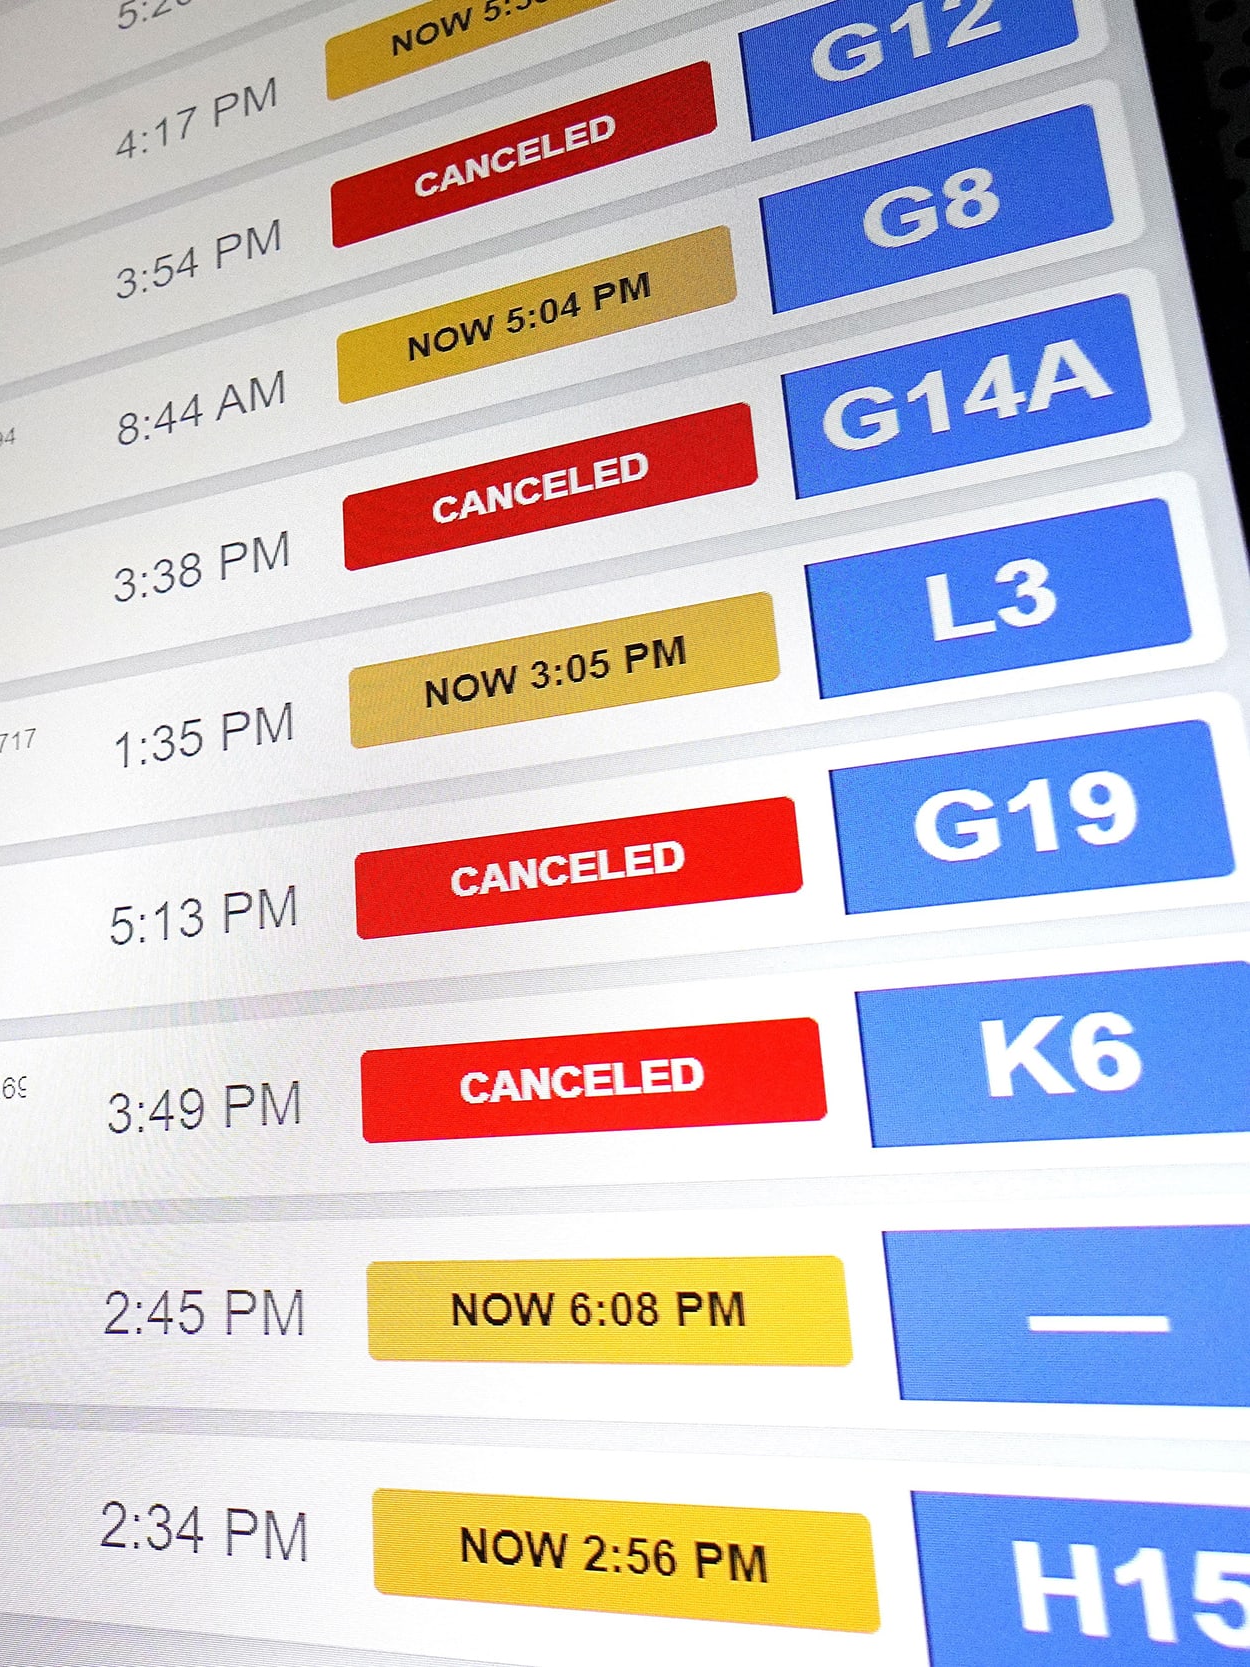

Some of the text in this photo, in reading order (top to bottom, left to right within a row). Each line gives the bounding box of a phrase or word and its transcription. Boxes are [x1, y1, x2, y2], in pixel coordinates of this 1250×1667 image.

[117, 0, 192, 31] 5:2
[391, 9, 471, 56] NOW
[811, 0, 1001, 81] G12
[115, 77, 277, 160] 4:17 PM
[415, 114, 616, 198] CANCELED
[863, 167, 1000, 249] G8
[116, 218, 281, 300] 3:54 PM
[408, 272, 651, 361] NOW 5:04 PM
[117, 369, 286, 446] 8:44 AM
[823, 338, 1114, 452] G14A
[432, 452, 649, 525] CANCELED
[114, 531, 290, 604] 3:38 PM
[926, 557, 1058, 642] L3
[425, 635, 686, 708] NOW 3:05 PM
[114, 701, 294, 769] 1:35 PM
[914, 770, 1139, 861] G19
[450, 841, 685, 898] CANCELED
[111, 885, 298, 946] 5:13 PM
[459, 1057, 703, 1105] CANCELED
[980, 1010, 1143, 1098] K6
[108, 1080, 301, 1135] 3:49 PM
[104, 1289, 306, 1337] 2:45 PM
[451, 1291, 746, 1328] NOW 6:08 PM
[101, 1501, 308, 1562] 2:34 PM
[460, 1526, 768, 1584] NOW 2:56 PM
